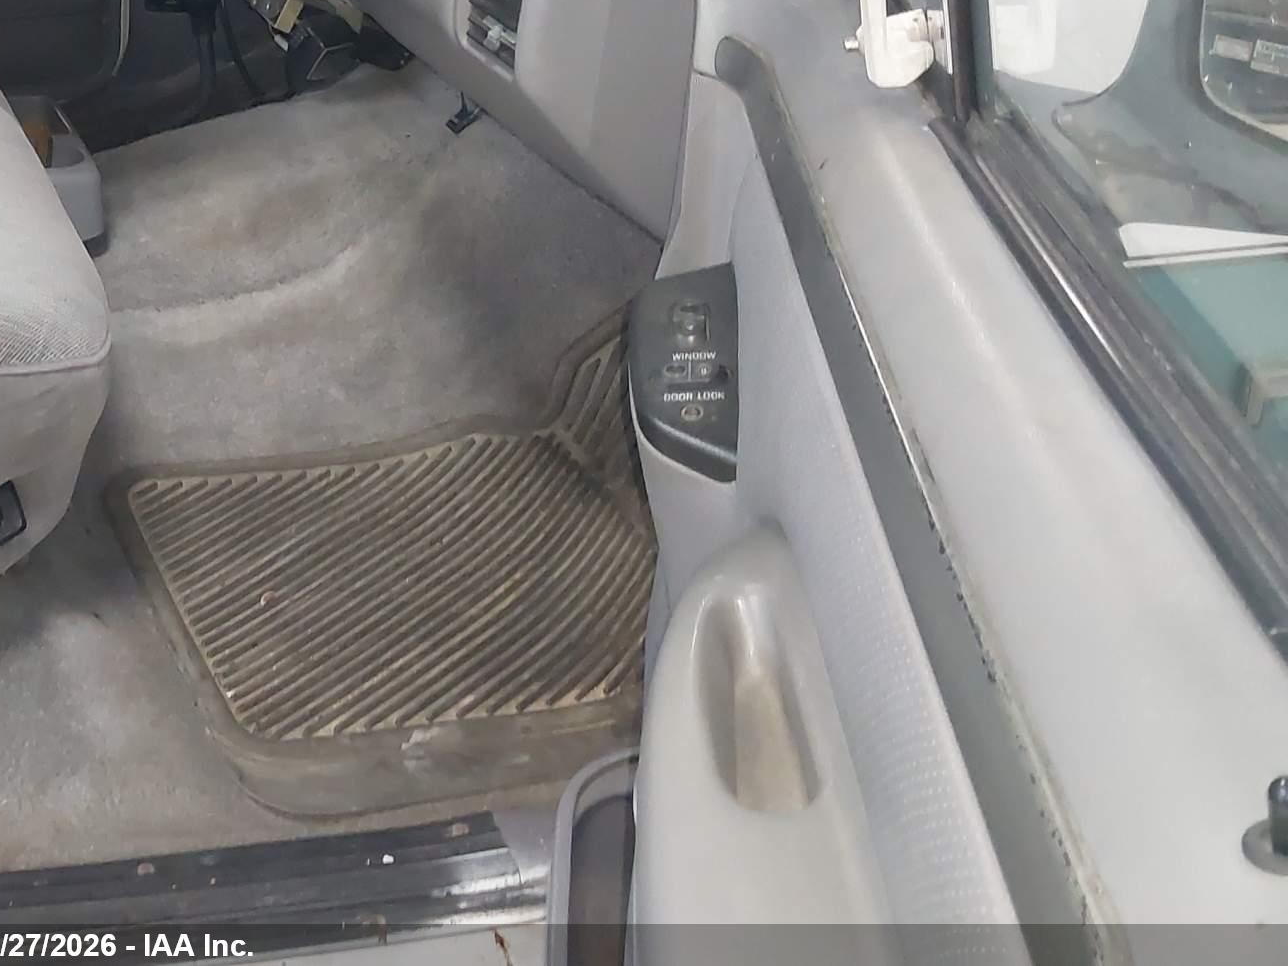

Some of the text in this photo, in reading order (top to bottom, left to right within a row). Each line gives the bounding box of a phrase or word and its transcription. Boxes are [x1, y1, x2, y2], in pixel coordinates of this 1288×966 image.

[672, 351, 716, 362] WINDOW
[663, 390, 725, 402] DOOR LOCK
